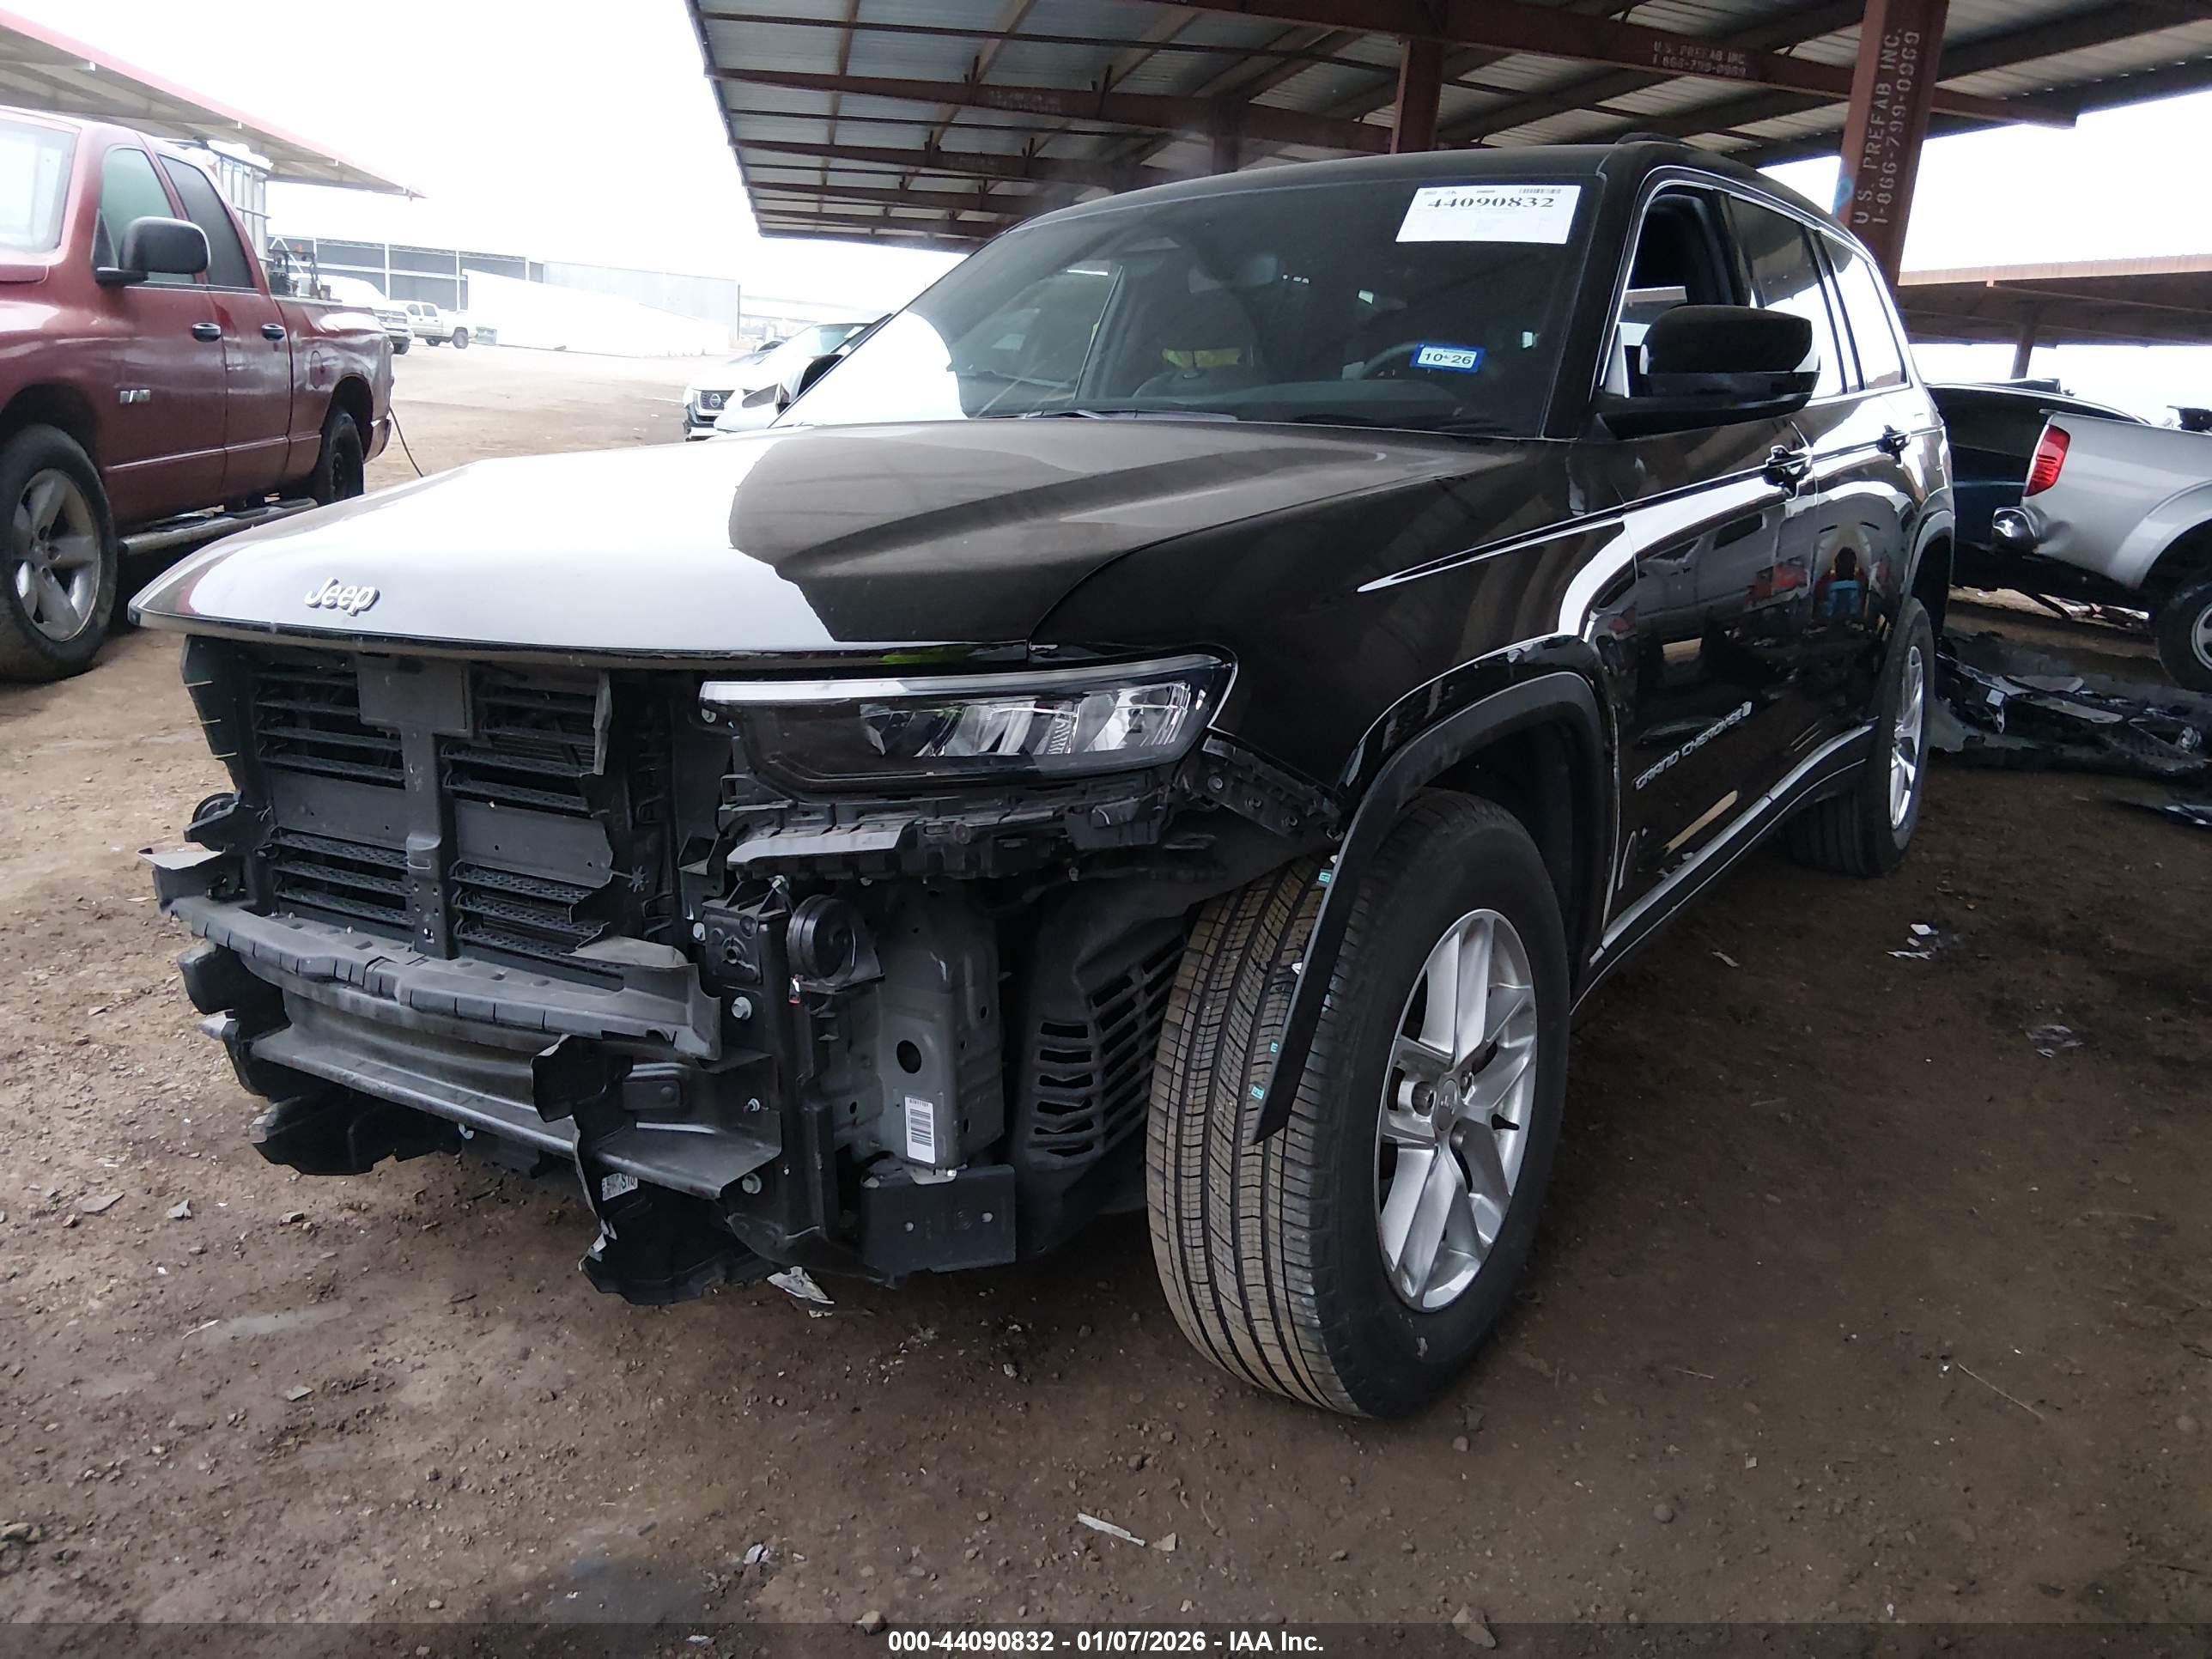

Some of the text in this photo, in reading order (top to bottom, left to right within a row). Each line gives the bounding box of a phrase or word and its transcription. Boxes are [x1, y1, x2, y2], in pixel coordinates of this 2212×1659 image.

[1863, 82, 1891, 169] PREFAB
[1880, 28, 1903, 70] INC.
[1872, 31, 1920, 223] 1-866-799-0969
[1427, 197, 1555, 208] 44090832
[304, 577, 380, 617] Jeep
